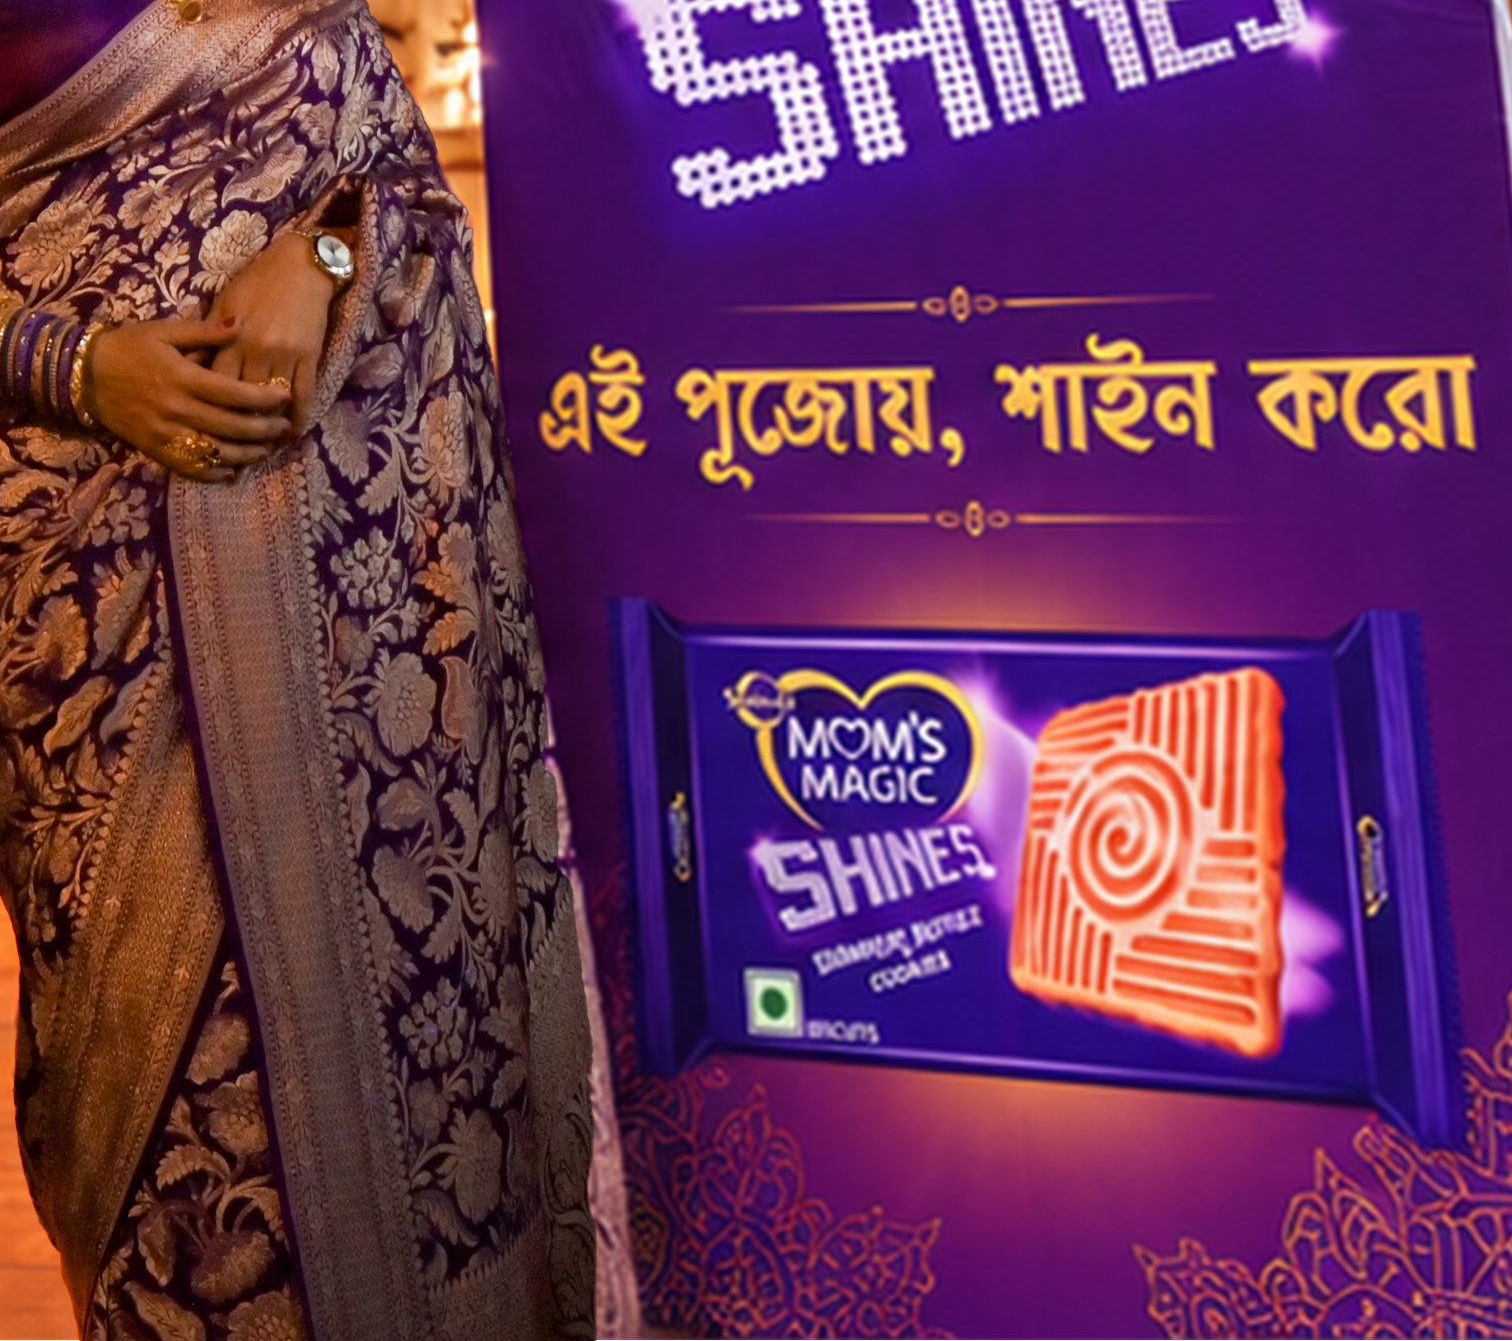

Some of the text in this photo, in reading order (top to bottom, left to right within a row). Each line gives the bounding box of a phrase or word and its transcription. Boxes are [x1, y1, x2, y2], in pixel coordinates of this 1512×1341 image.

[540, 333, 1476, 490] এই পূজোয়, শাইন করো
[787, 710, 947, 763] MOM'S
[802, 763, 938, 804] MAGIC
[758, 825, 993, 931] SHINES
